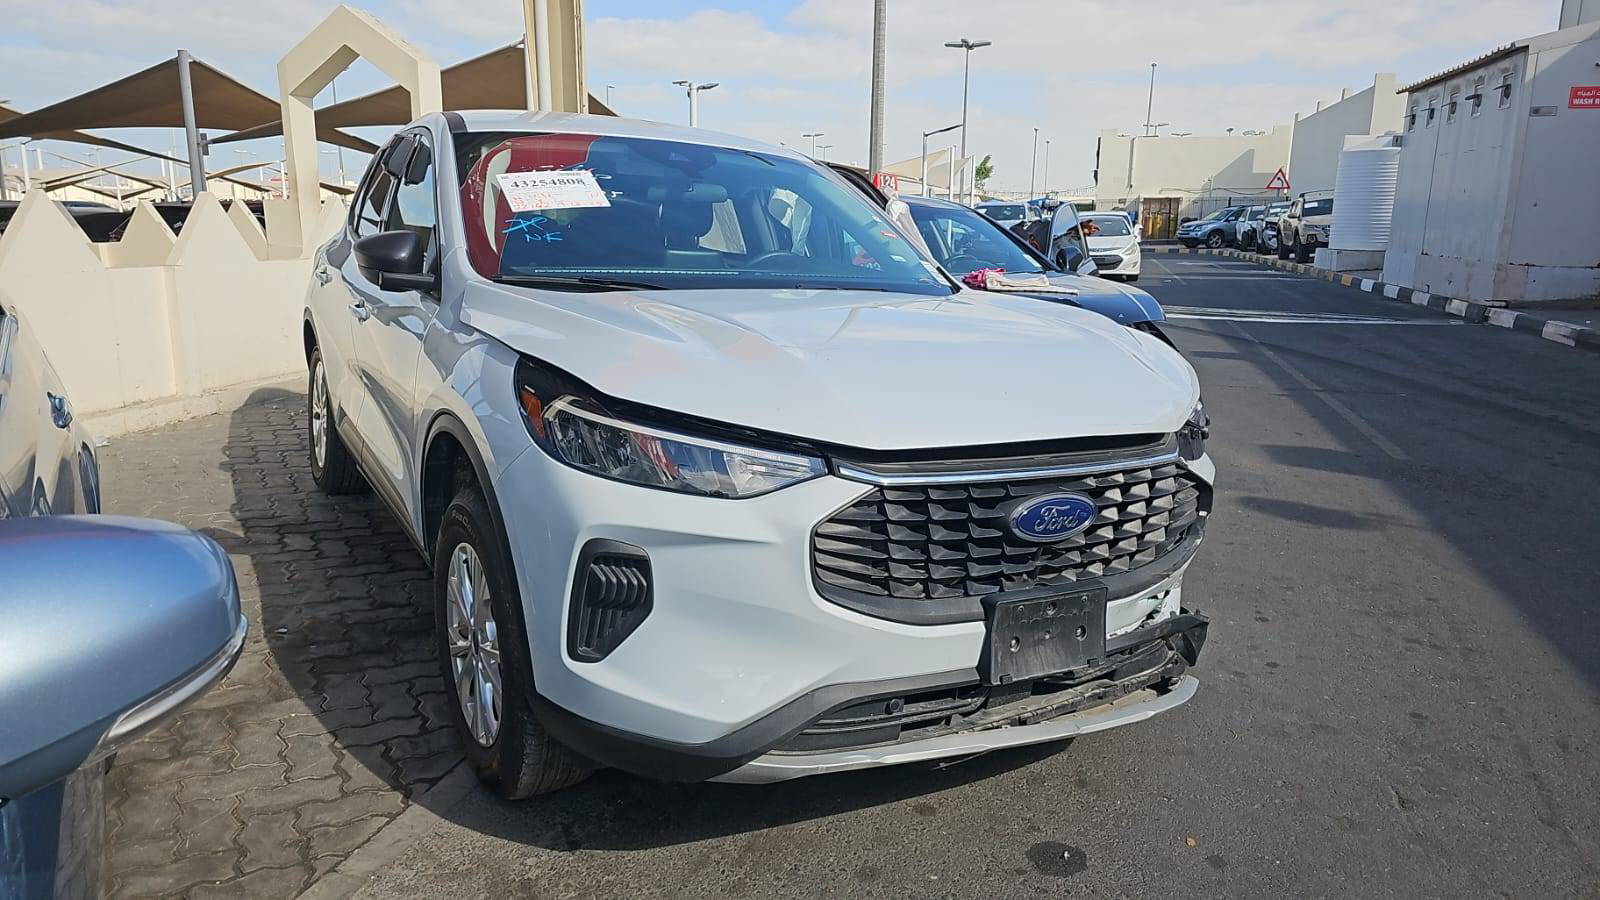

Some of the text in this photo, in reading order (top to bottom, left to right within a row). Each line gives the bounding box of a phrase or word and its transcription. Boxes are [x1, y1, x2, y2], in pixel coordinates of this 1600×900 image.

[510, 178, 585, 188] 43254808
[880, 175, 895, 190] 124
[1034, 505, 1080, 532] Ford
